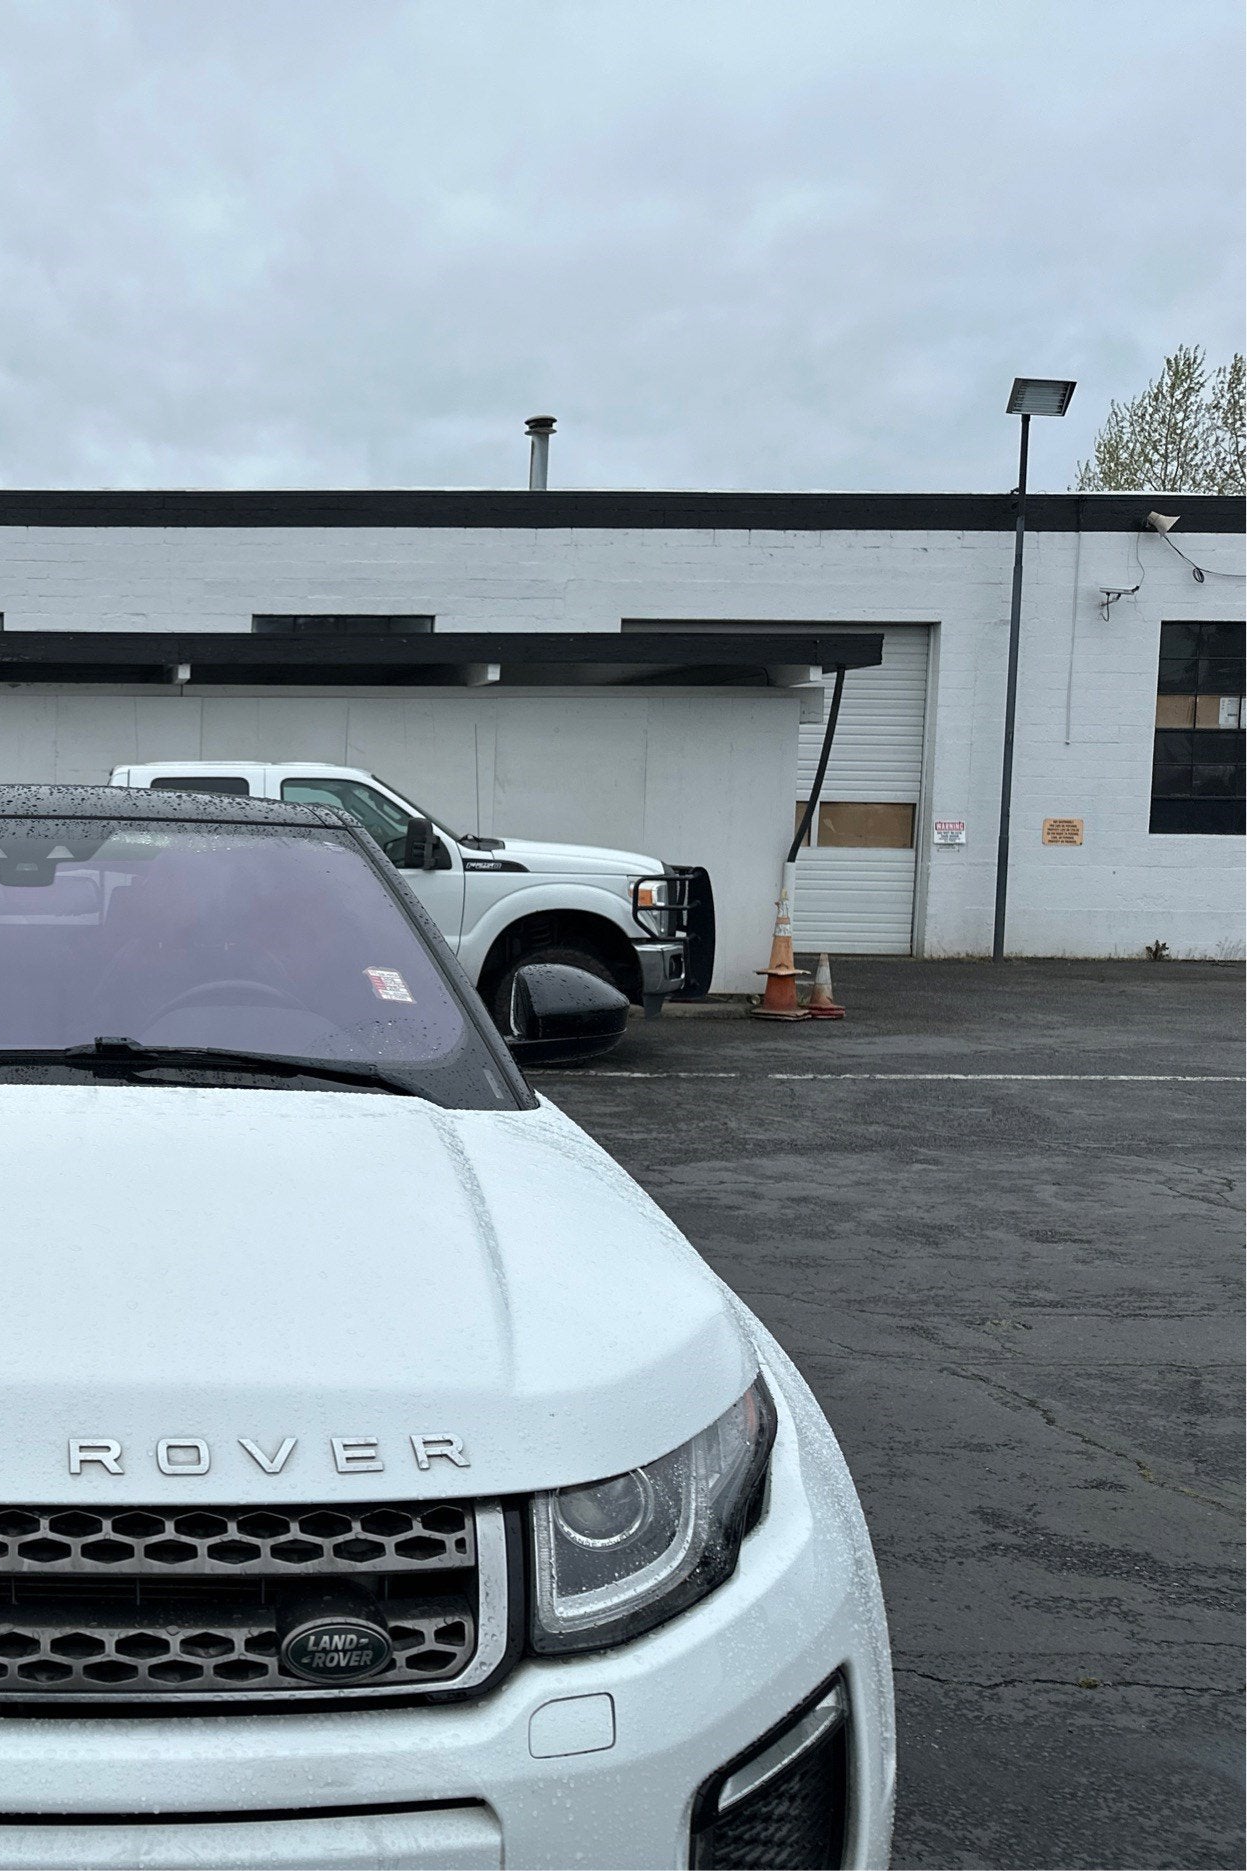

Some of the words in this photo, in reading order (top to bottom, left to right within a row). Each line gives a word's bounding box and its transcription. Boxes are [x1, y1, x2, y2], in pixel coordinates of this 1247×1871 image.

[936, 822, 964, 830] WARNING
[68, 1432, 472, 1475] ROVER
[307, 1634, 358, 1652] LAND
[312, 1650, 374, 1668] ROVER
